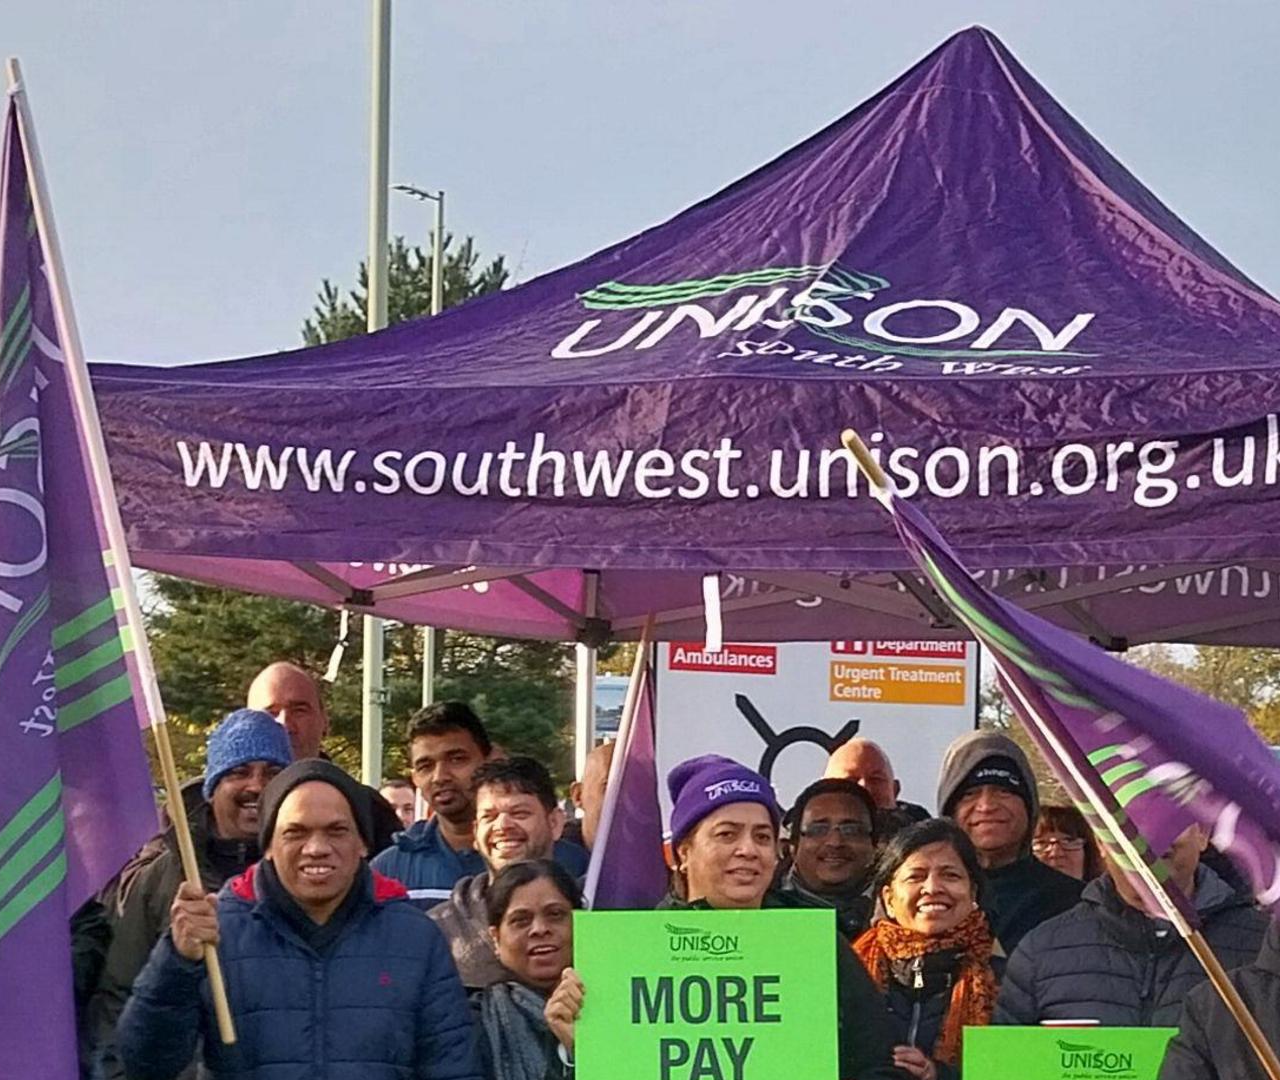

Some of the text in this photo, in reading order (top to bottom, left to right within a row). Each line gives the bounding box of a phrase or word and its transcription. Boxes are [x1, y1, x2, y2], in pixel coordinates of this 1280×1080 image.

[550, 282, 1096, 359] UNISON
[718, 340, 904, 373] South
[673, 646, 774, 669] Ambulances
[834, 664, 962, 684] Urgent Treatment
[834, 683, 882, 699] Centre
[670, 935, 739, 952] UNISON
[631, 975, 782, 1024] MORE
[1061, 1053, 1132, 1069] UNISON
